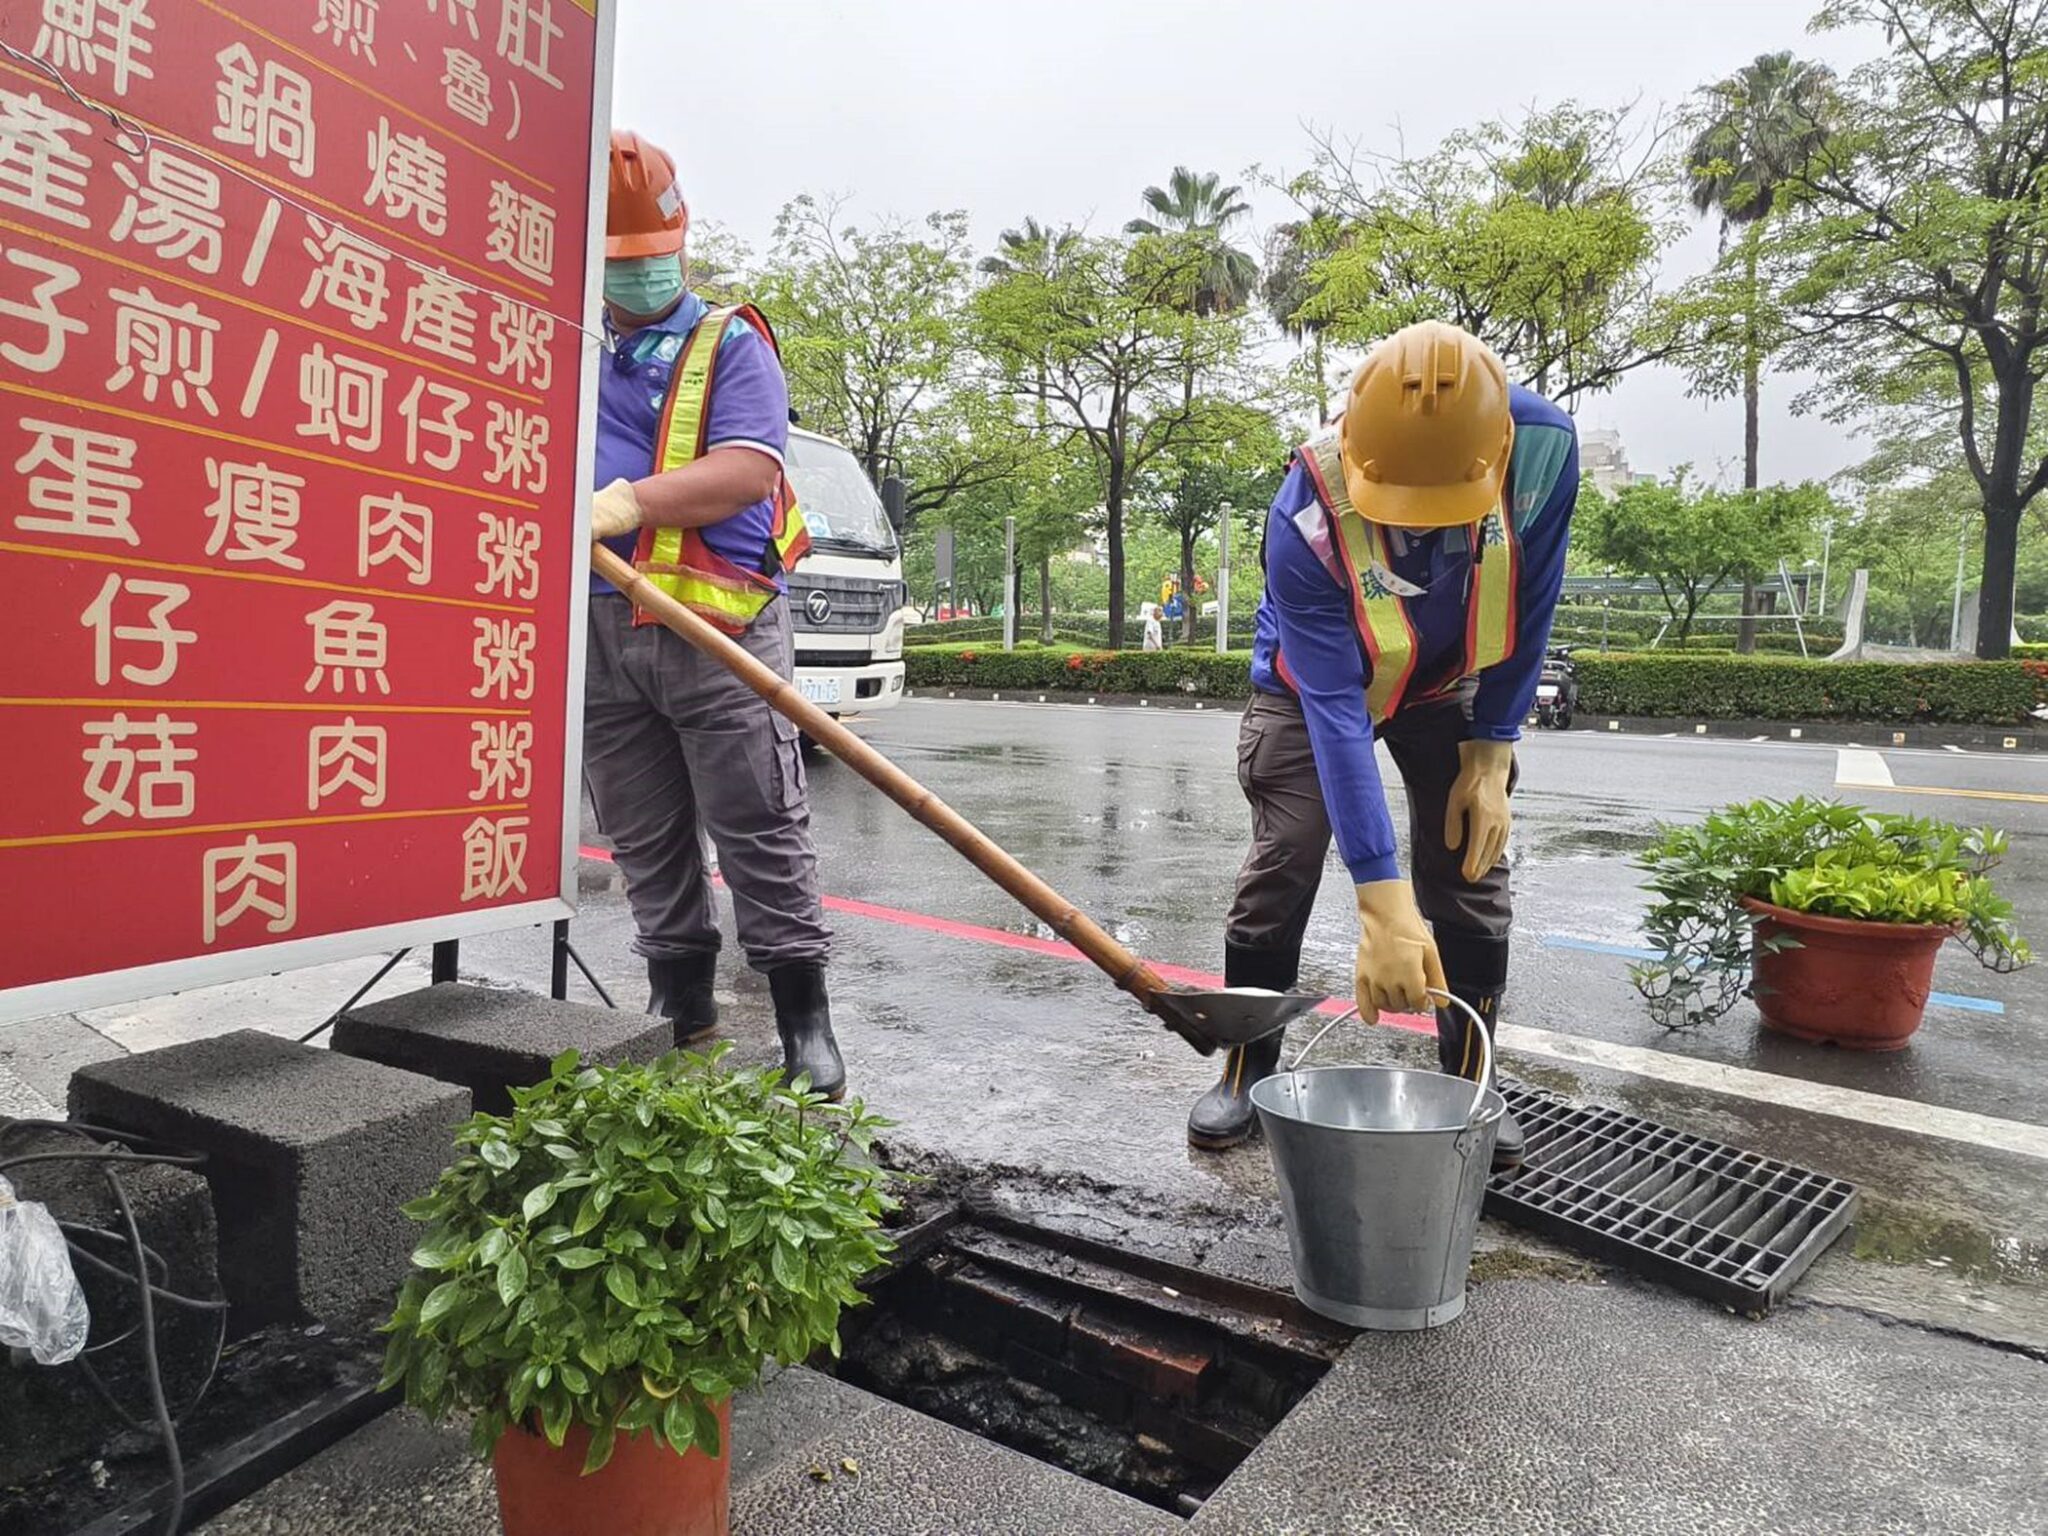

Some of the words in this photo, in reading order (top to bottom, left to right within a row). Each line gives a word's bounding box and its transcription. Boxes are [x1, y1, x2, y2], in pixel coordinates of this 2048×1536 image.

[14, 417, 541, 600] 蛋瘦肉粥
[80, 572, 537, 700] 仔魚粥
[81, 712, 533, 825] 菇肉粥
